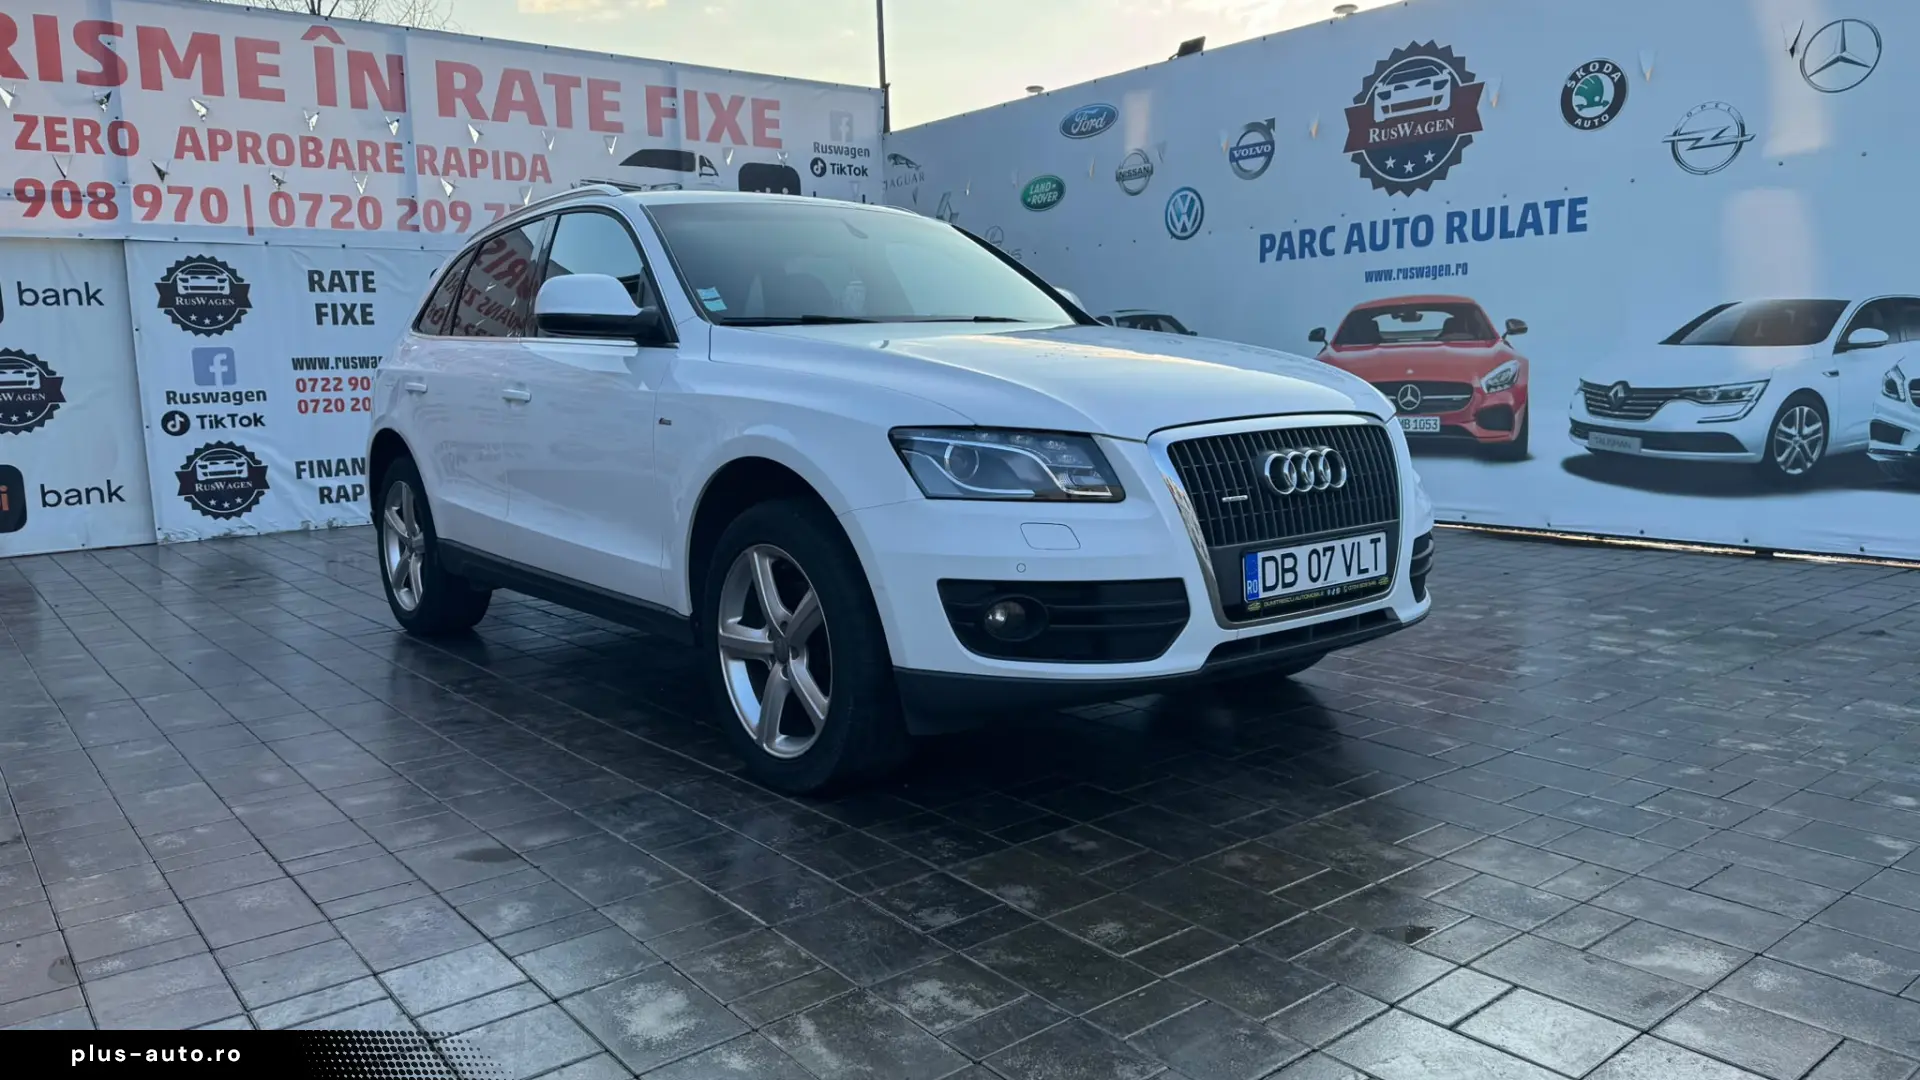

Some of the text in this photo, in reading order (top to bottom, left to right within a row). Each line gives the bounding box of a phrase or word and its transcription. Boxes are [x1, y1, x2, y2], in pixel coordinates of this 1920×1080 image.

[301, 25, 406, 113] ÎN
[435, 60, 624, 134] RATE
[645, 85, 784, 149] FIXE
[1071, 108, 1107, 134] Ford
[1574, 113, 1609, 128] AUTO
[13, 114, 552, 185] ZERO APROBARE RAPIDA
[813, 141, 871, 159] Ruswagen
[1232, 144, 1272, 158] VOLVO
[829, 162, 869, 177] TikTok
[1118, 166, 1150, 179] NISSAN
[883, 171, 925, 191] JAGUAR
[1029, 181, 1051, 195] LAND
[13, 178, 119, 221] 908
[132, 183, 228, 224] 970
[268, 190, 382, 230] 0720
[396, 198, 472, 234] 209
[1031, 191, 1059, 205] ROVER
[1259, 196, 1588, 264] PARC AUTO RULATE
[307, 269, 376, 294] RATE
[1364, 262, 1468, 283] www.ruswagen.ro
[17, 281, 104, 307] bank
[315, 303, 375, 326] FIXE
[296, 376, 371, 393] 0722 90
[165, 389, 267, 406] Ruswagen
[297, 397, 371, 414] 0720 20
[196, 412, 266, 430] TikTok
[1412, 419, 1438, 430] 1053
[295, 457, 366, 480] FINAN
[40, 480, 126, 508] bank
[318, 483, 365, 504] RAP
[1261, 537, 1381, 592] DB 07 VLT
[1246, 579, 1258, 594] RO
